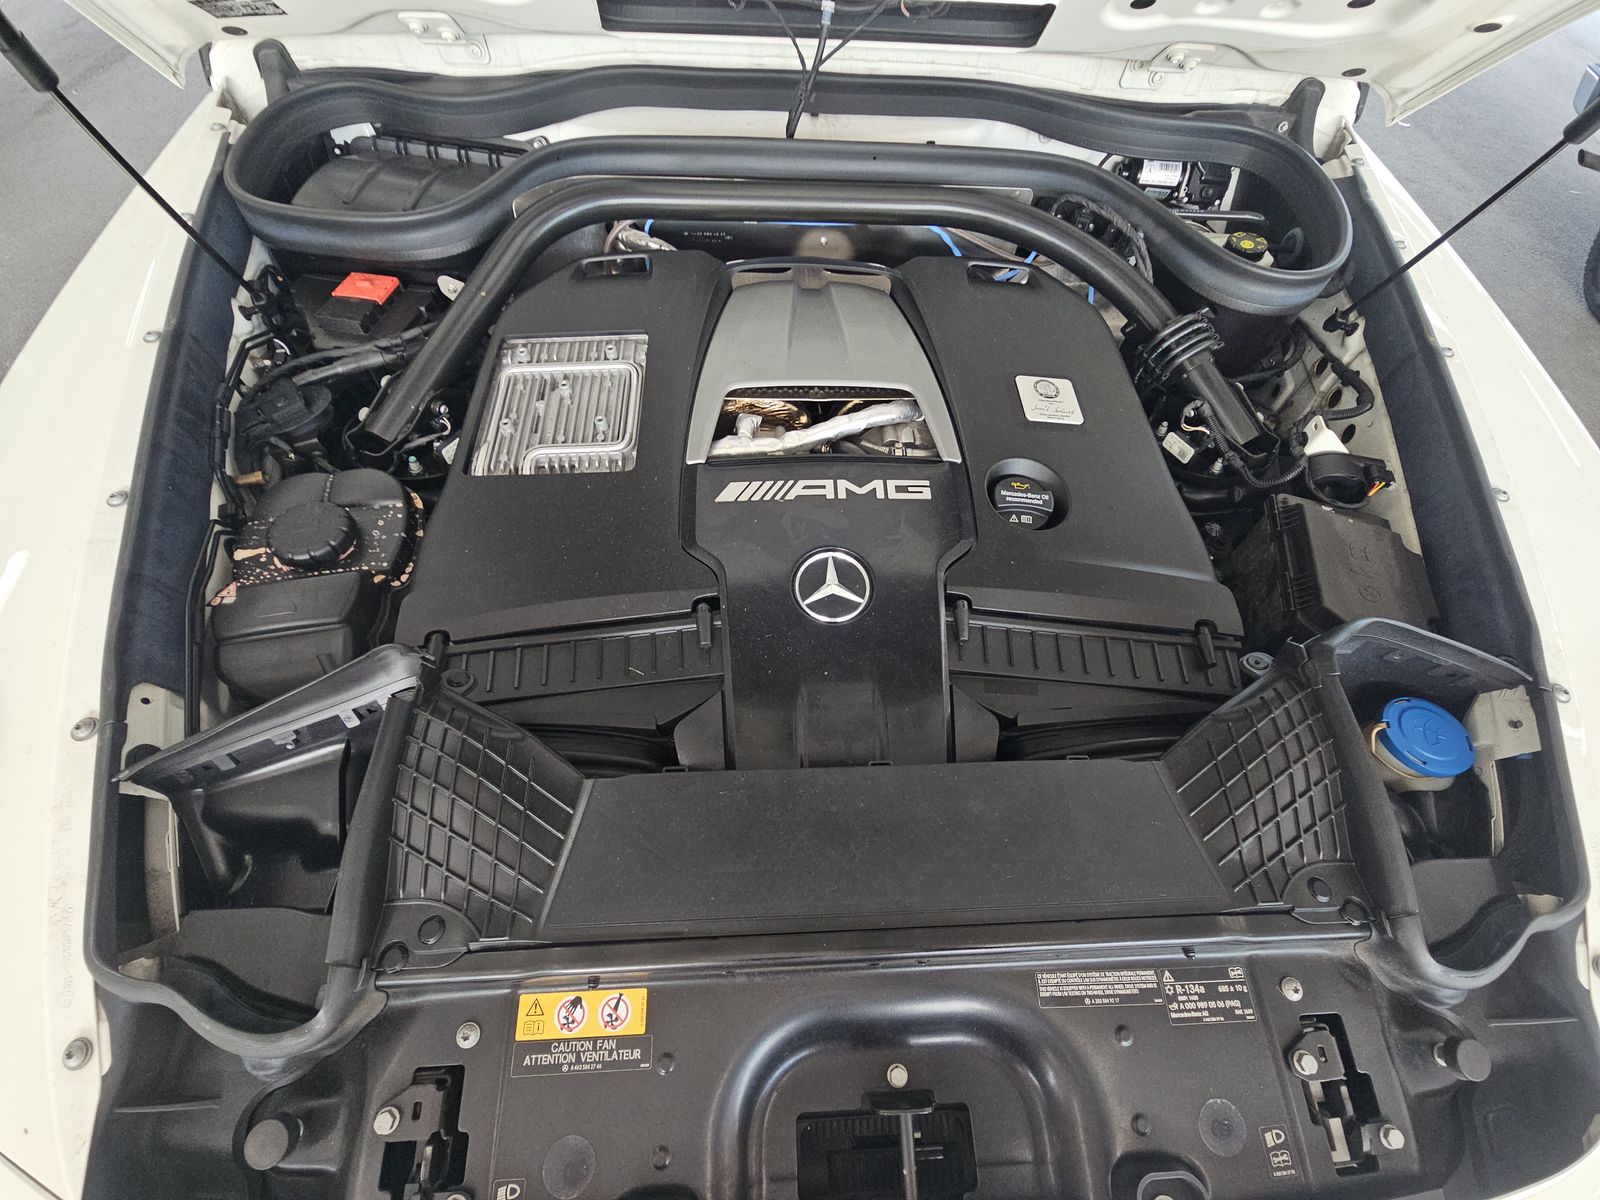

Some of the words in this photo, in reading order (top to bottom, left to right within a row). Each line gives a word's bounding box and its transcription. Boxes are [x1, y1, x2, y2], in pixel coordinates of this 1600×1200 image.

[784, 479, 932, 500] AMG
[1001, 490, 1040, 500] Mercedes-Benz
[1006, 496, 1043, 505] recommended
[1176, 984, 1206, 995] R-134a
[551, 1041, 593, 1053] CAUTION
[597, 1040, 616, 1051] FAN
[523, 1053, 576, 1066] ATTENTION
[580, 1049, 641, 1062] VENTILATEUR
